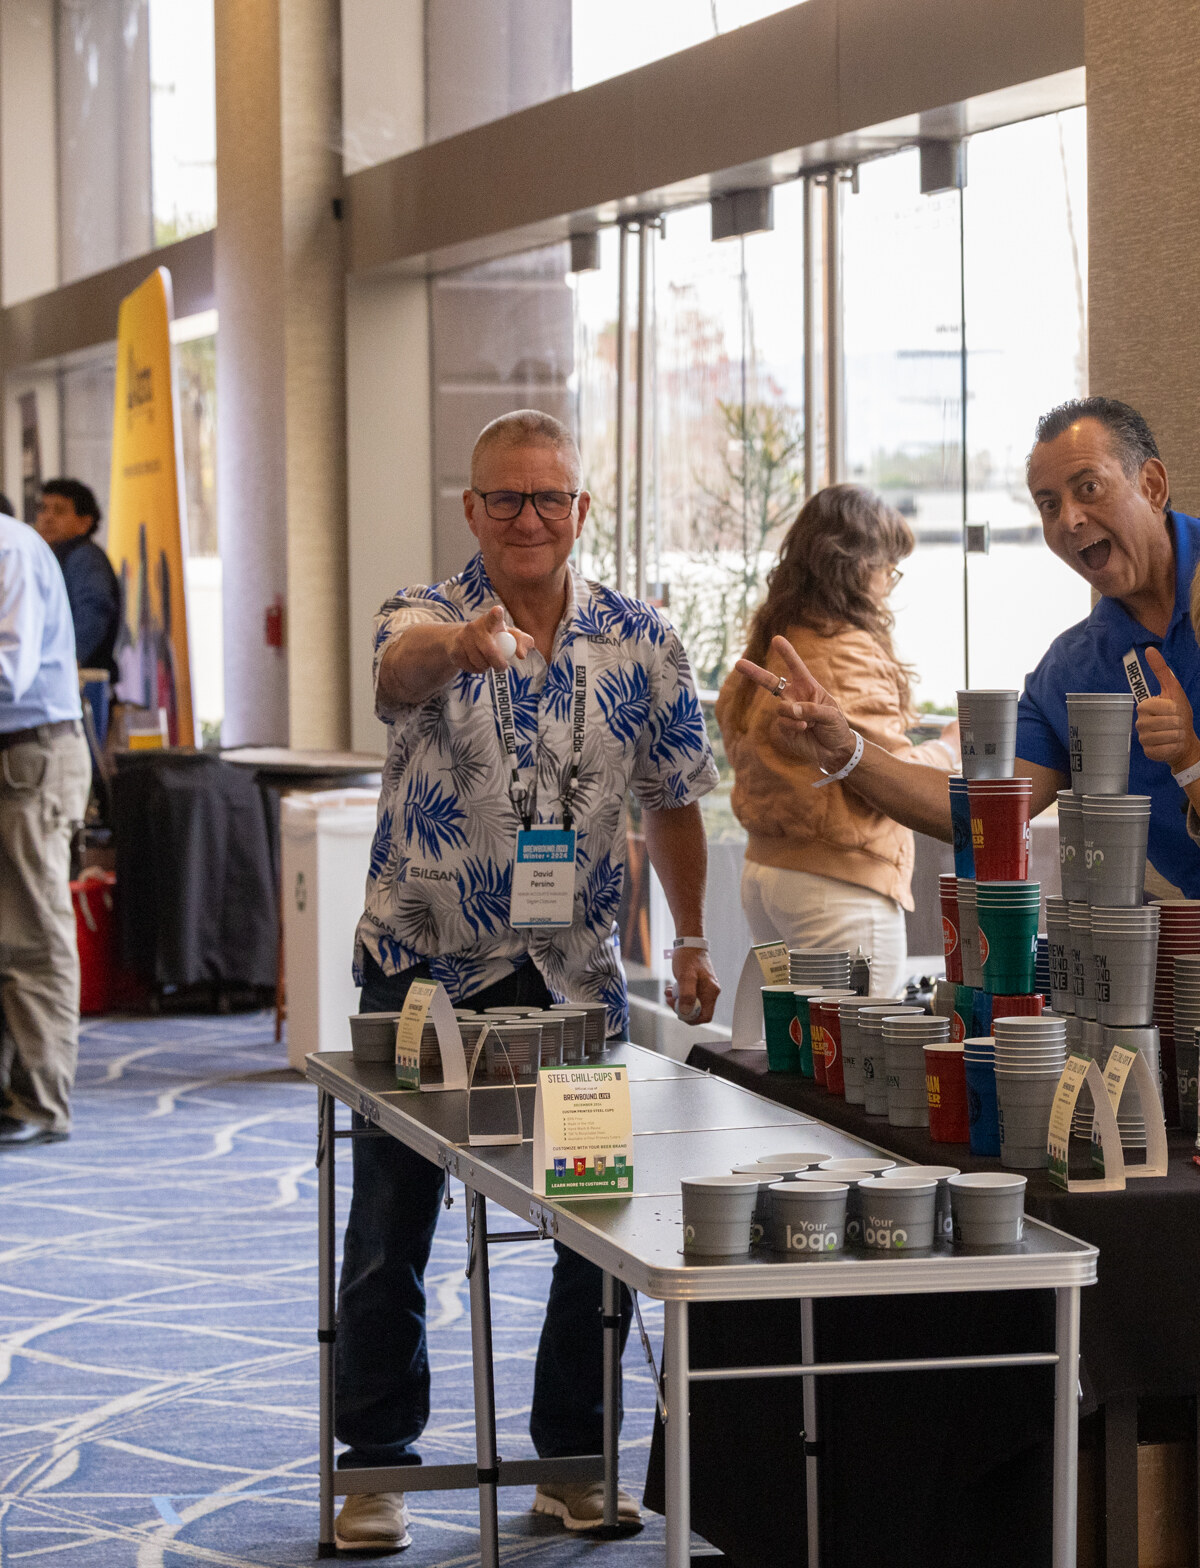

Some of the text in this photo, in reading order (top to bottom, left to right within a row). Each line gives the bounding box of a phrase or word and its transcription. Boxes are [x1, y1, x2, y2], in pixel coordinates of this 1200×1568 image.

[587, 634, 621, 648] ILGAN
[1127, 661, 1149, 703] BREWBO
[494, 672, 514, 732] REWBOUND.
[1060, 844, 1075, 864] go
[1085, 849, 1104, 869] go
[531, 880, 554, 888] Persino
[548, 1072, 613, 1083] STEEL CHILL-CUPS
[801, 1221, 828, 1232] Your
[869, 1216, 894, 1230] Your
[787, 1225, 838, 1251] logo
